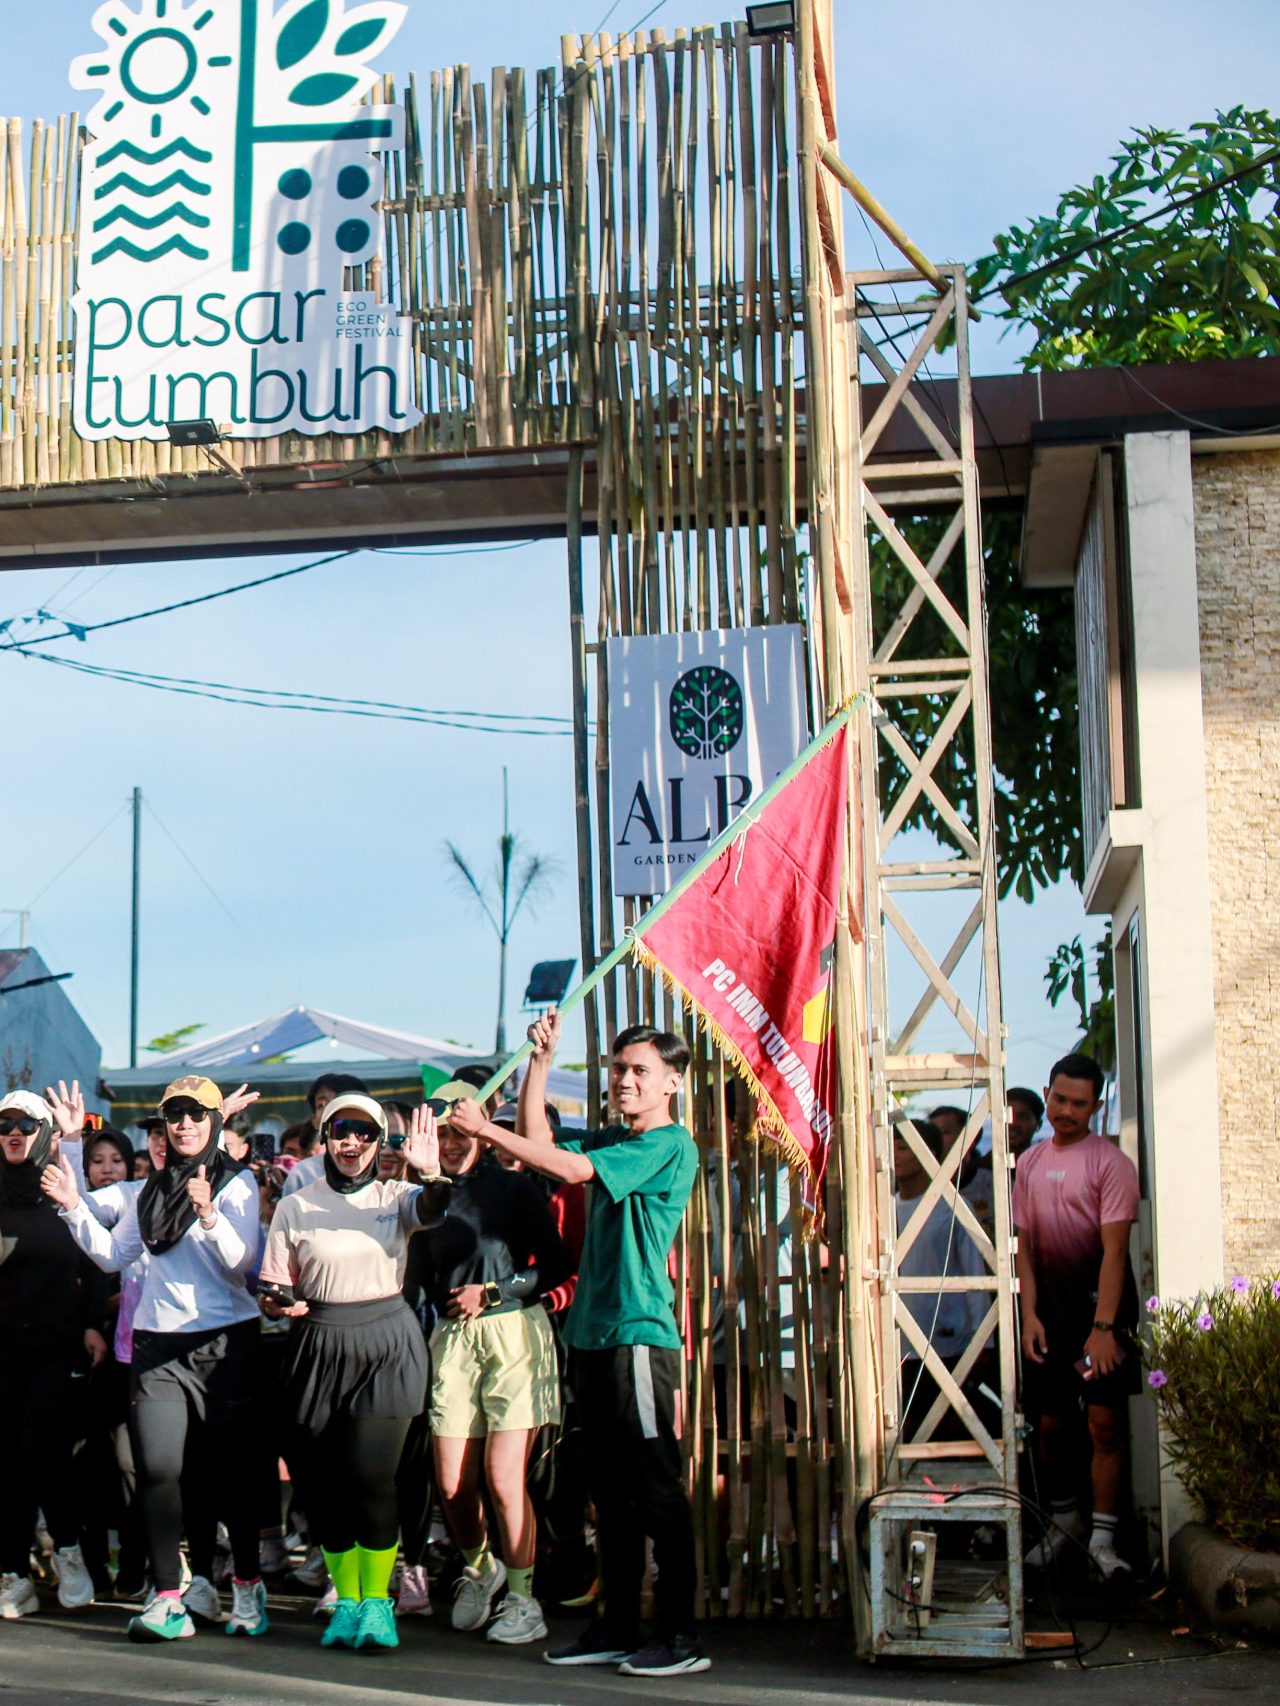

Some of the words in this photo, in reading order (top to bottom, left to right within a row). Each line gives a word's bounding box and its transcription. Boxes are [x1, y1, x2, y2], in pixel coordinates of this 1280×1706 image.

[336, 301, 367, 312] ECO
[87, 287, 326, 354] pasar
[335, 314, 386, 326] GREEN
[335, 327, 404, 338] FESTIVAL
[86, 343, 407, 429] tumbuh
[634, 853, 697, 866] GARDEN
[702, 957, 737, 993] PC
[725, 982, 770, 1033] IMM
